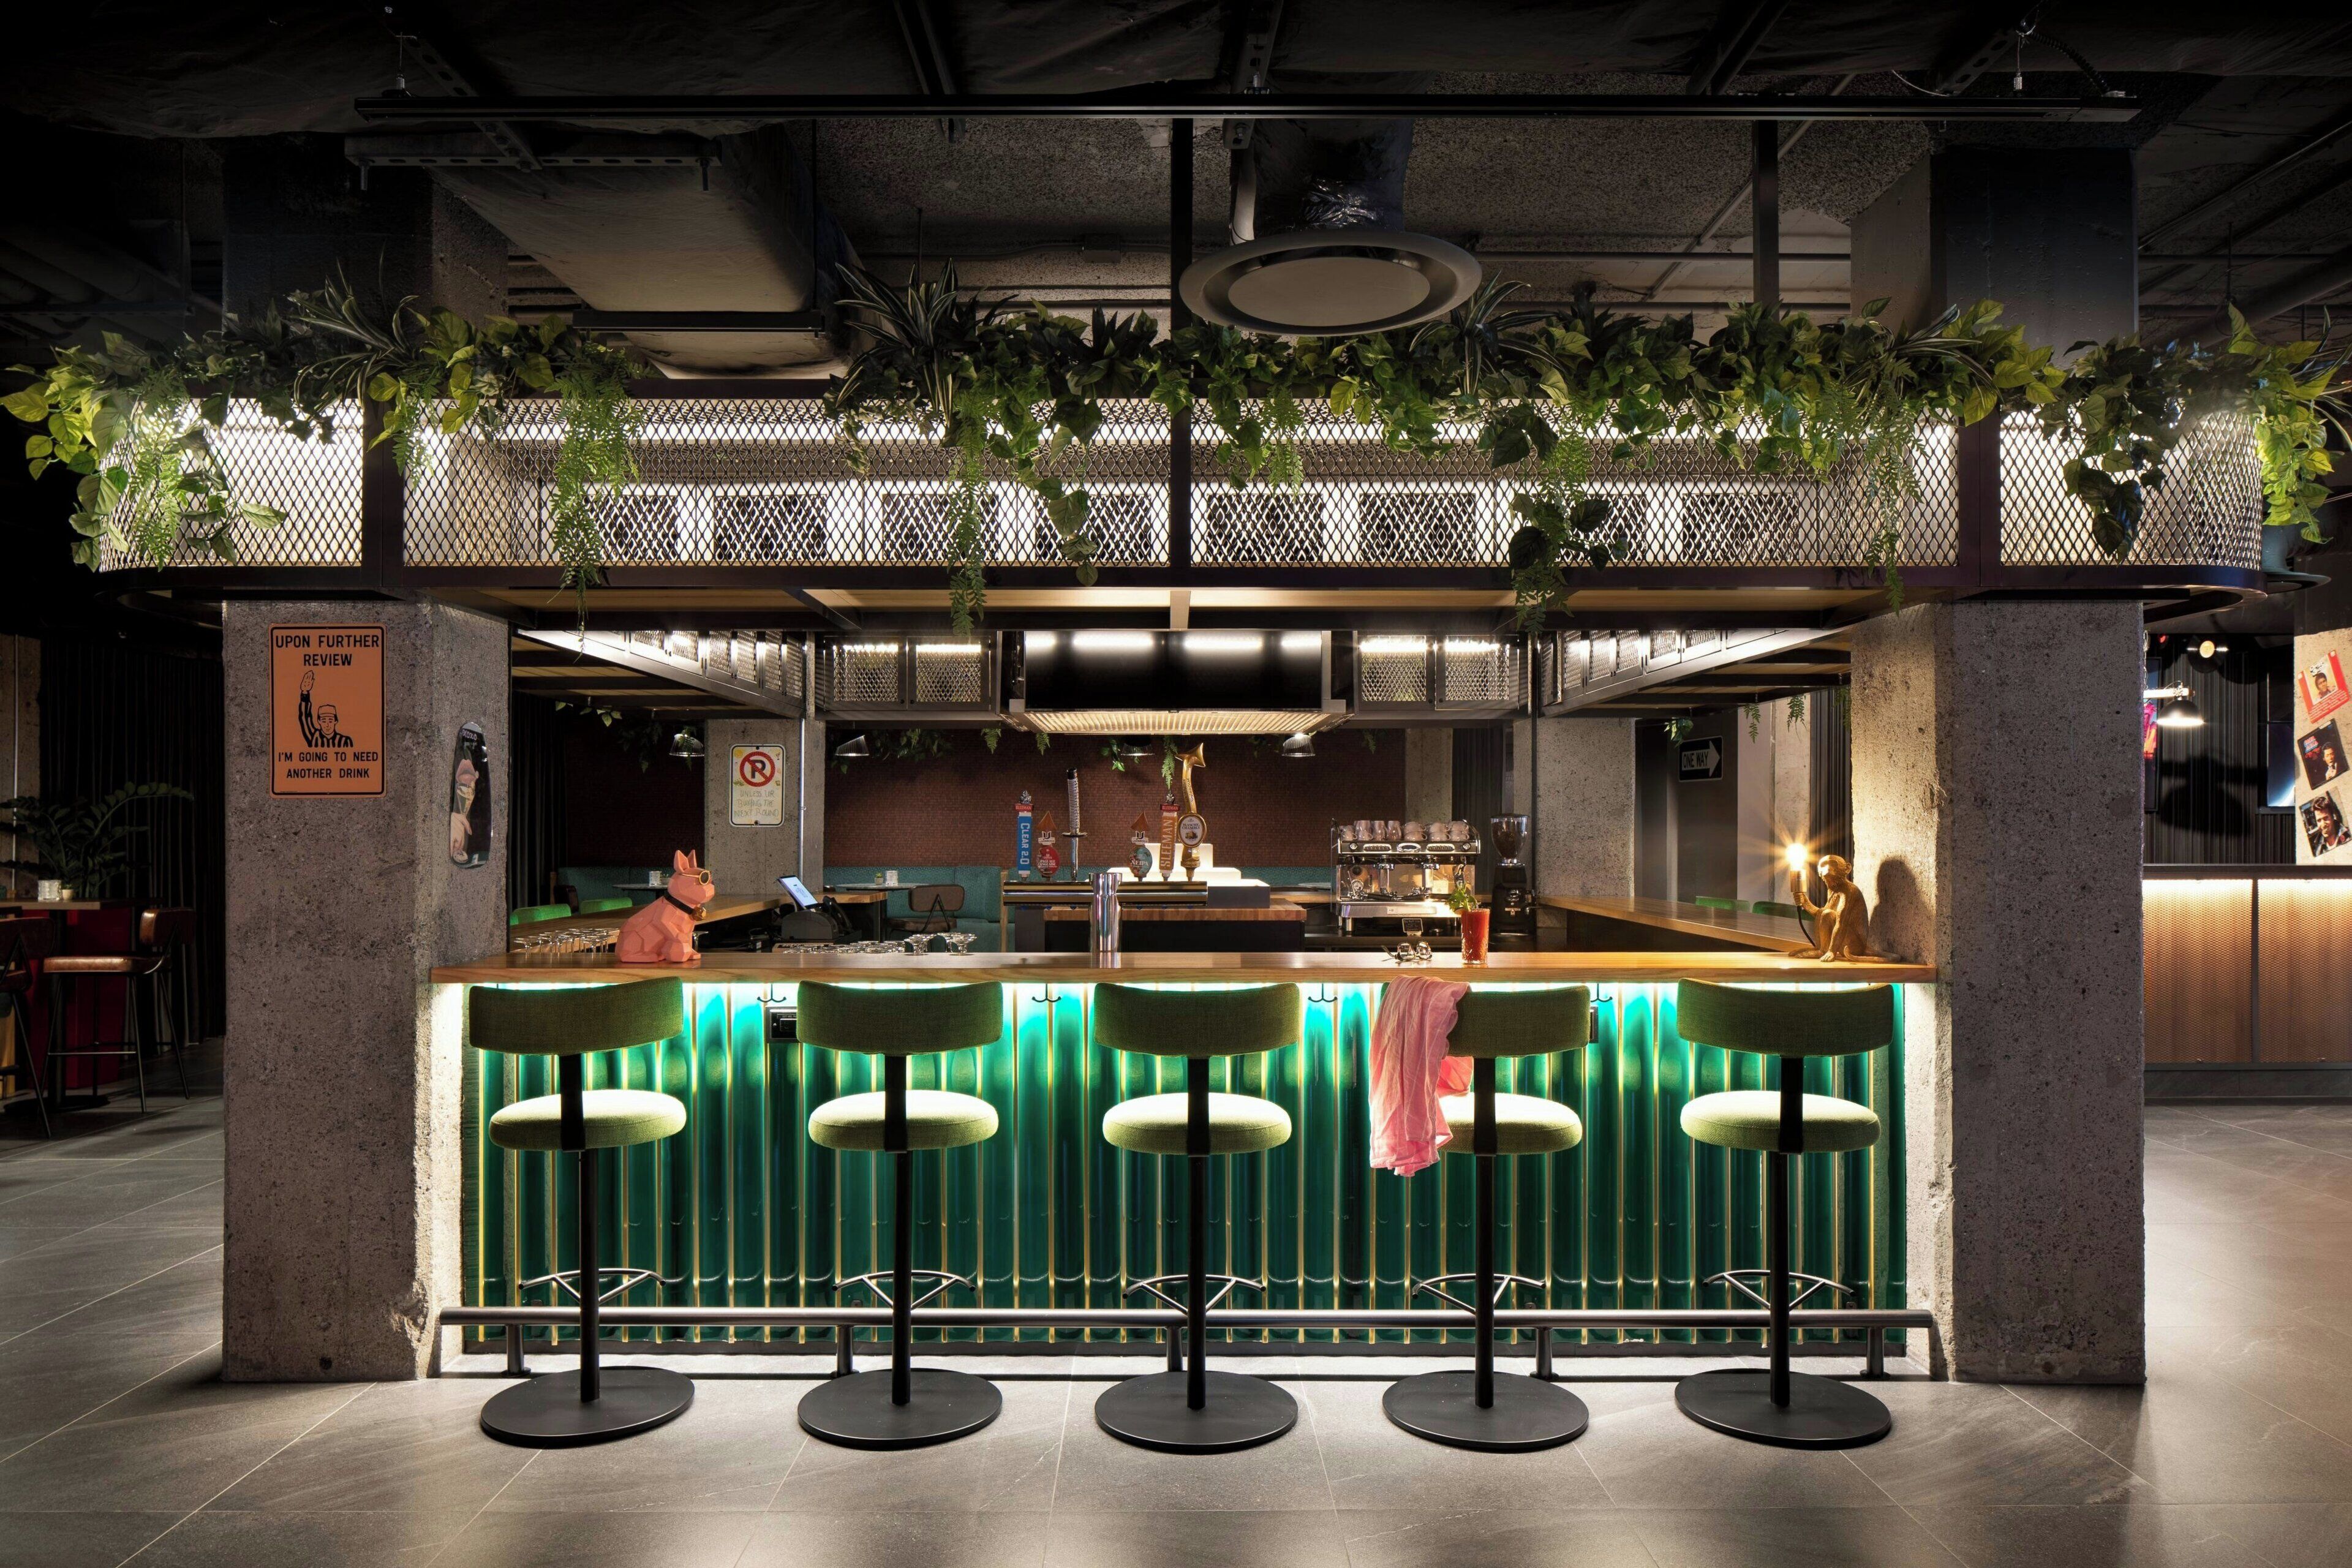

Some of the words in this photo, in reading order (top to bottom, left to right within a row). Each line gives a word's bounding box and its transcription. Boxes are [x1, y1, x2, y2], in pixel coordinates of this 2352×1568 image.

[276, 635, 310, 648] UPON
[318, 635, 379, 647] FURTHER
[303, 654, 352, 666] REVIEW
[278, 752, 292, 762] I'M
[299, 752, 328, 762] GOING
[334, 752, 346, 762] TO
[353, 752, 379, 762] NEED
[1683, 753, 1695, 768] ONE
[1697, 751, 1708, 767] WAY
[287, 769, 331, 778] ANOTHER
[339, 769, 369, 778] DRINK
[750, 760, 766, 779] P
[734, 809, 755, 817] NEXT
[755, 808, 779, 817] ROUND
[1020, 823, 1030, 848] CLEAR
[1161, 820, 1173, 867] SLEEMAN
[1020, 851, 1030, 864] 2.0
